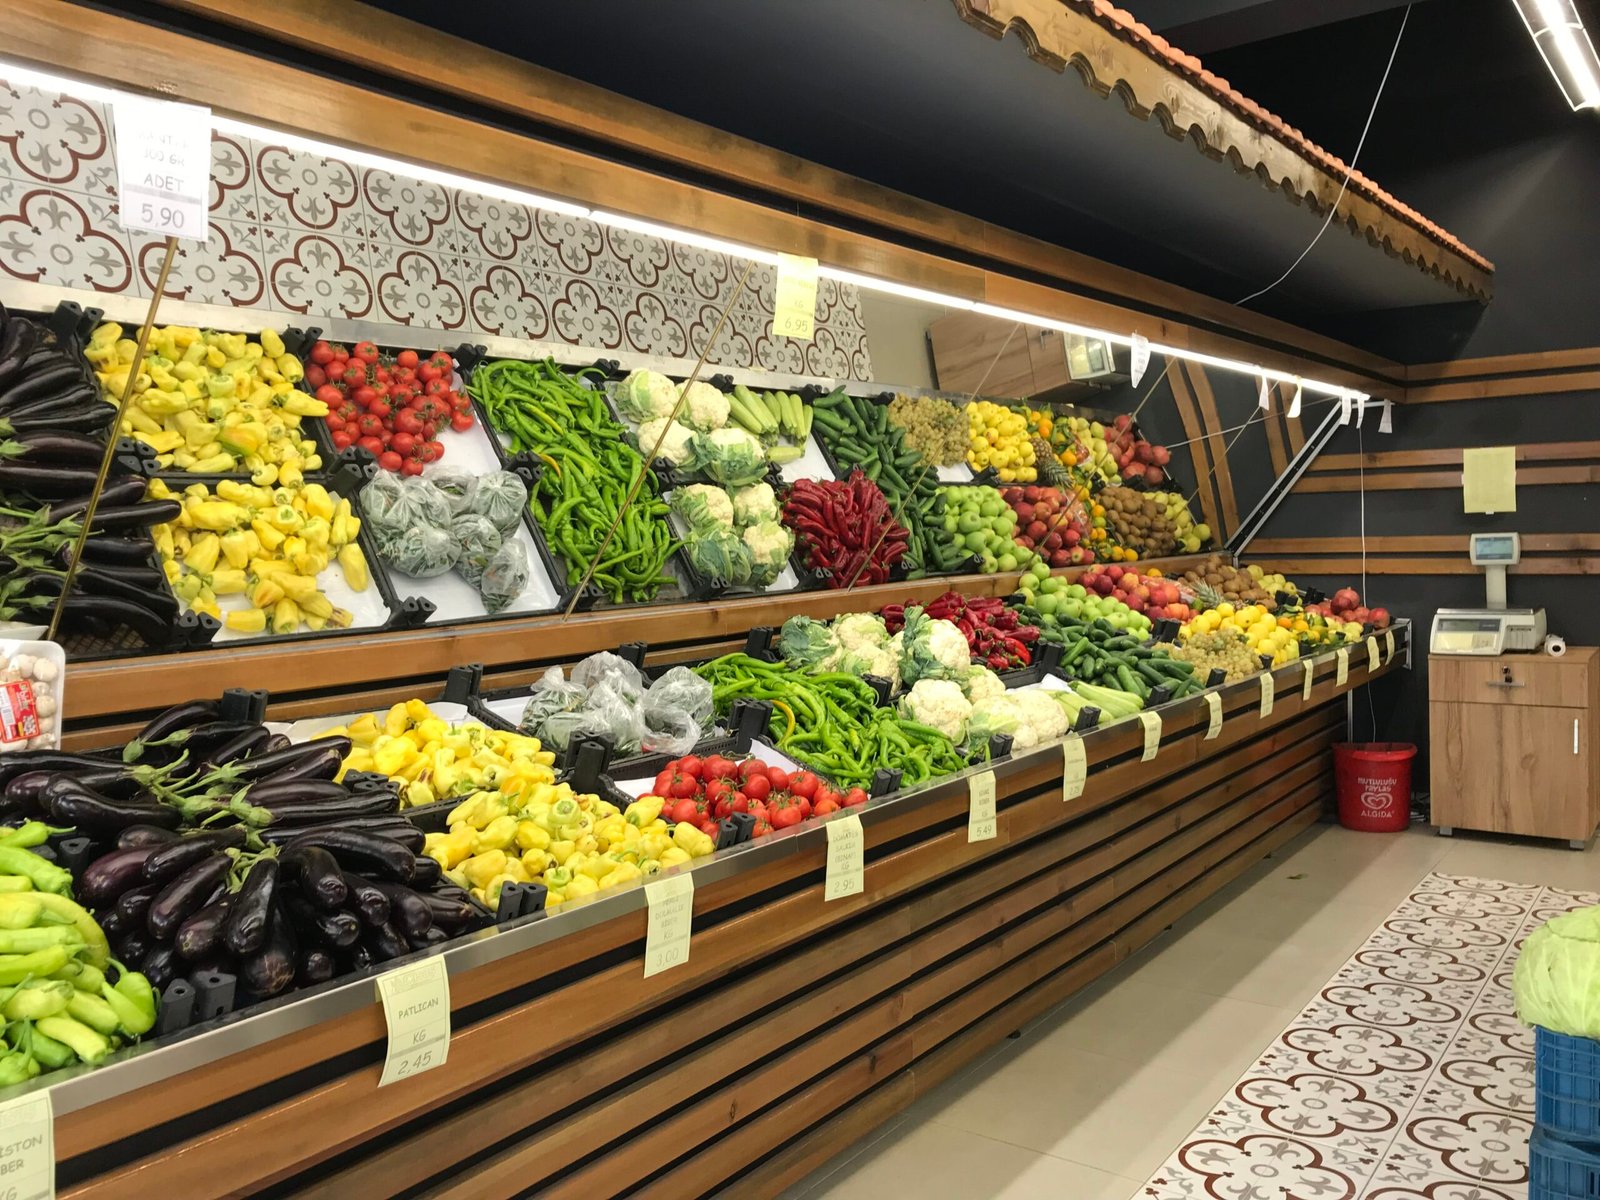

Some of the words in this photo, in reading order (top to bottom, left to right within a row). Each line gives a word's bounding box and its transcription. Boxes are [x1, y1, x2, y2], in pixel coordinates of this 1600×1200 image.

[143, 172, 185, 193] ADET
[141, 202, 185, 229] 5,90
[1360, 809, 1393, 818] ALGIDA
[655, 947, 680, 968] 3,00
[398, 997, 440, 1020] PATLICAN
[412, 1029, 427, 1045] KG
[398, 1050, 433, 1076] 2,45
